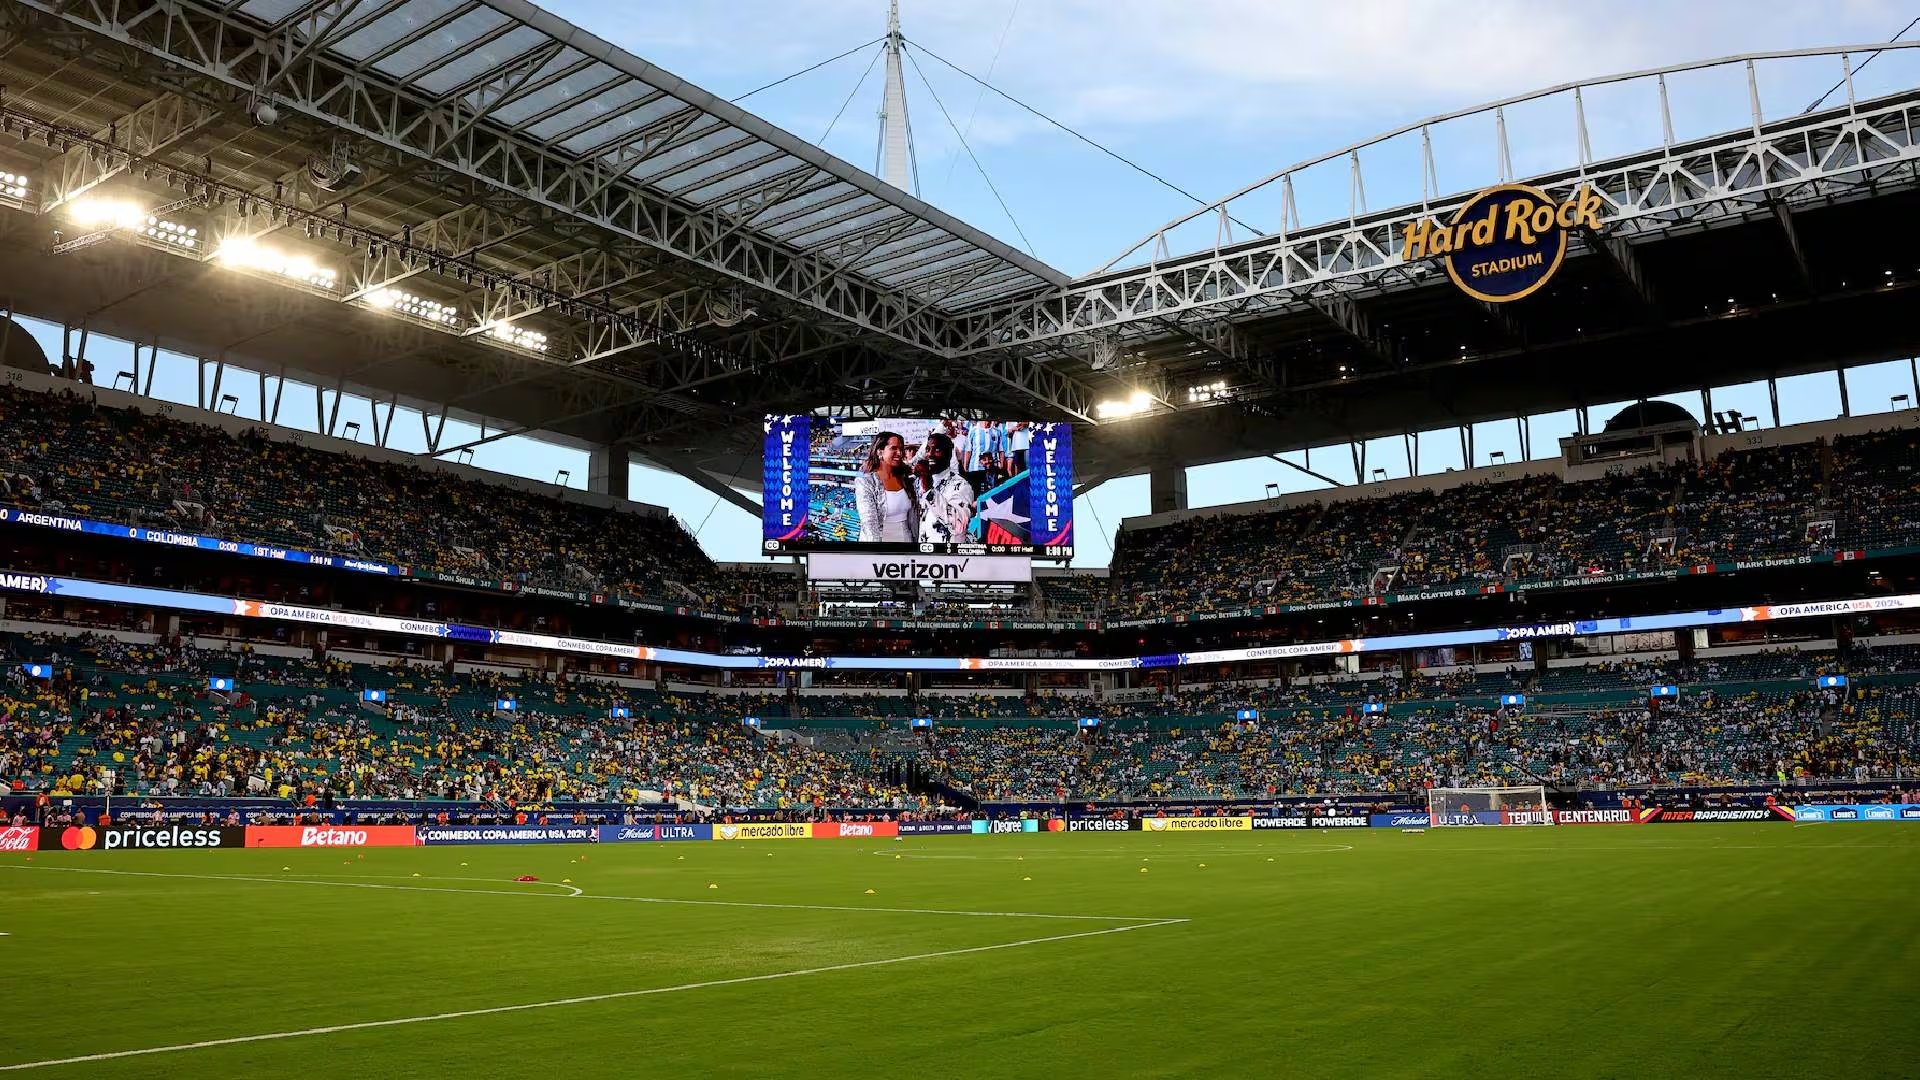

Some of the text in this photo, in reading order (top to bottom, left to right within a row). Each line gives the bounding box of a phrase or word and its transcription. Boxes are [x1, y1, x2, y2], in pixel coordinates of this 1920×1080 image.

[1402, 184, 1603, 261] Hard Rock
[1471, 252, 1543, 278] STADIUM
[5, 371, 23, 381] 318
[159, 405, 173, 414] 319
[1607, 463, 1624, 473] 332
[780, 430, 796, 526] WELCOME
[1043, 437, 1059, 532] WELCOME
[0, 509, 82, 531] 0 ARGENTINA
[129, 528, 199, 547] 0 COLOMBIA
[219, 541, 238, 552] 0:00
[254, 546, 269, 557] 1ST
[1062, 547, 1073, 556] PM
[873, 559, 959, 579] verizon
[1736, 556, 1812, 570] MARK DUPER 85
[438, 573, 454, 583] DON
[455, 576, 476, 586] SHULA
[1563, 577, 1580, 587] DAN
[1581, 575, 1613, 585] MARINO
[521, 585, 536, 594] NICK
[578, 593, 587, 601] 85
[1397, 589, 1466, 602] MARK CLAYTON 83
[1288, 604, 1306, 613] JOHN
[1343, 600, 1353, 608] 56
[1803, 603, 1850, 614] AMERICA
[1852, 601, 1872, 609] USA
[291, 608, 330, 621] AMERICA
[1200, 612, 1217, 621] DOUG
[1243, 608, 1252, 616] 75
[814, 619, 857, 628] STEPHENSON
[962, 621, 973, 629] 67
[1012, 621, 1046, 630] RICHMOND
[1066, 622, 1076, 630] 78
[557, 639, 595, 652] CONMEBOL
[1246, 647, 1287, 657] CONMEBOL
[1171, 817, 1244, 828] mercado libre
[1253, 818, 1307, 828] POWERADE
[1312, 817, 1368, 827] POWERADE
[1391, 816, 1430, 826] Michelob
[1438, 815, 1479, 824] ULTRA
[1508, 811, 1554, 824] TEQUILA
[741, 825, 804, 837] mercado libre
[839, 823, 873, 836] Betano
[993, 819, 1022, 834] Degree
[1070, 817, 1129, 832] priceless
[104, 825, 221, 849] priceless
[301, 826, 367, 845] Betano
[428, 829, 587, 840] CONMEBOL COPA AMERICA USA 2024
[661, 826, 695, 838] ULTRA
